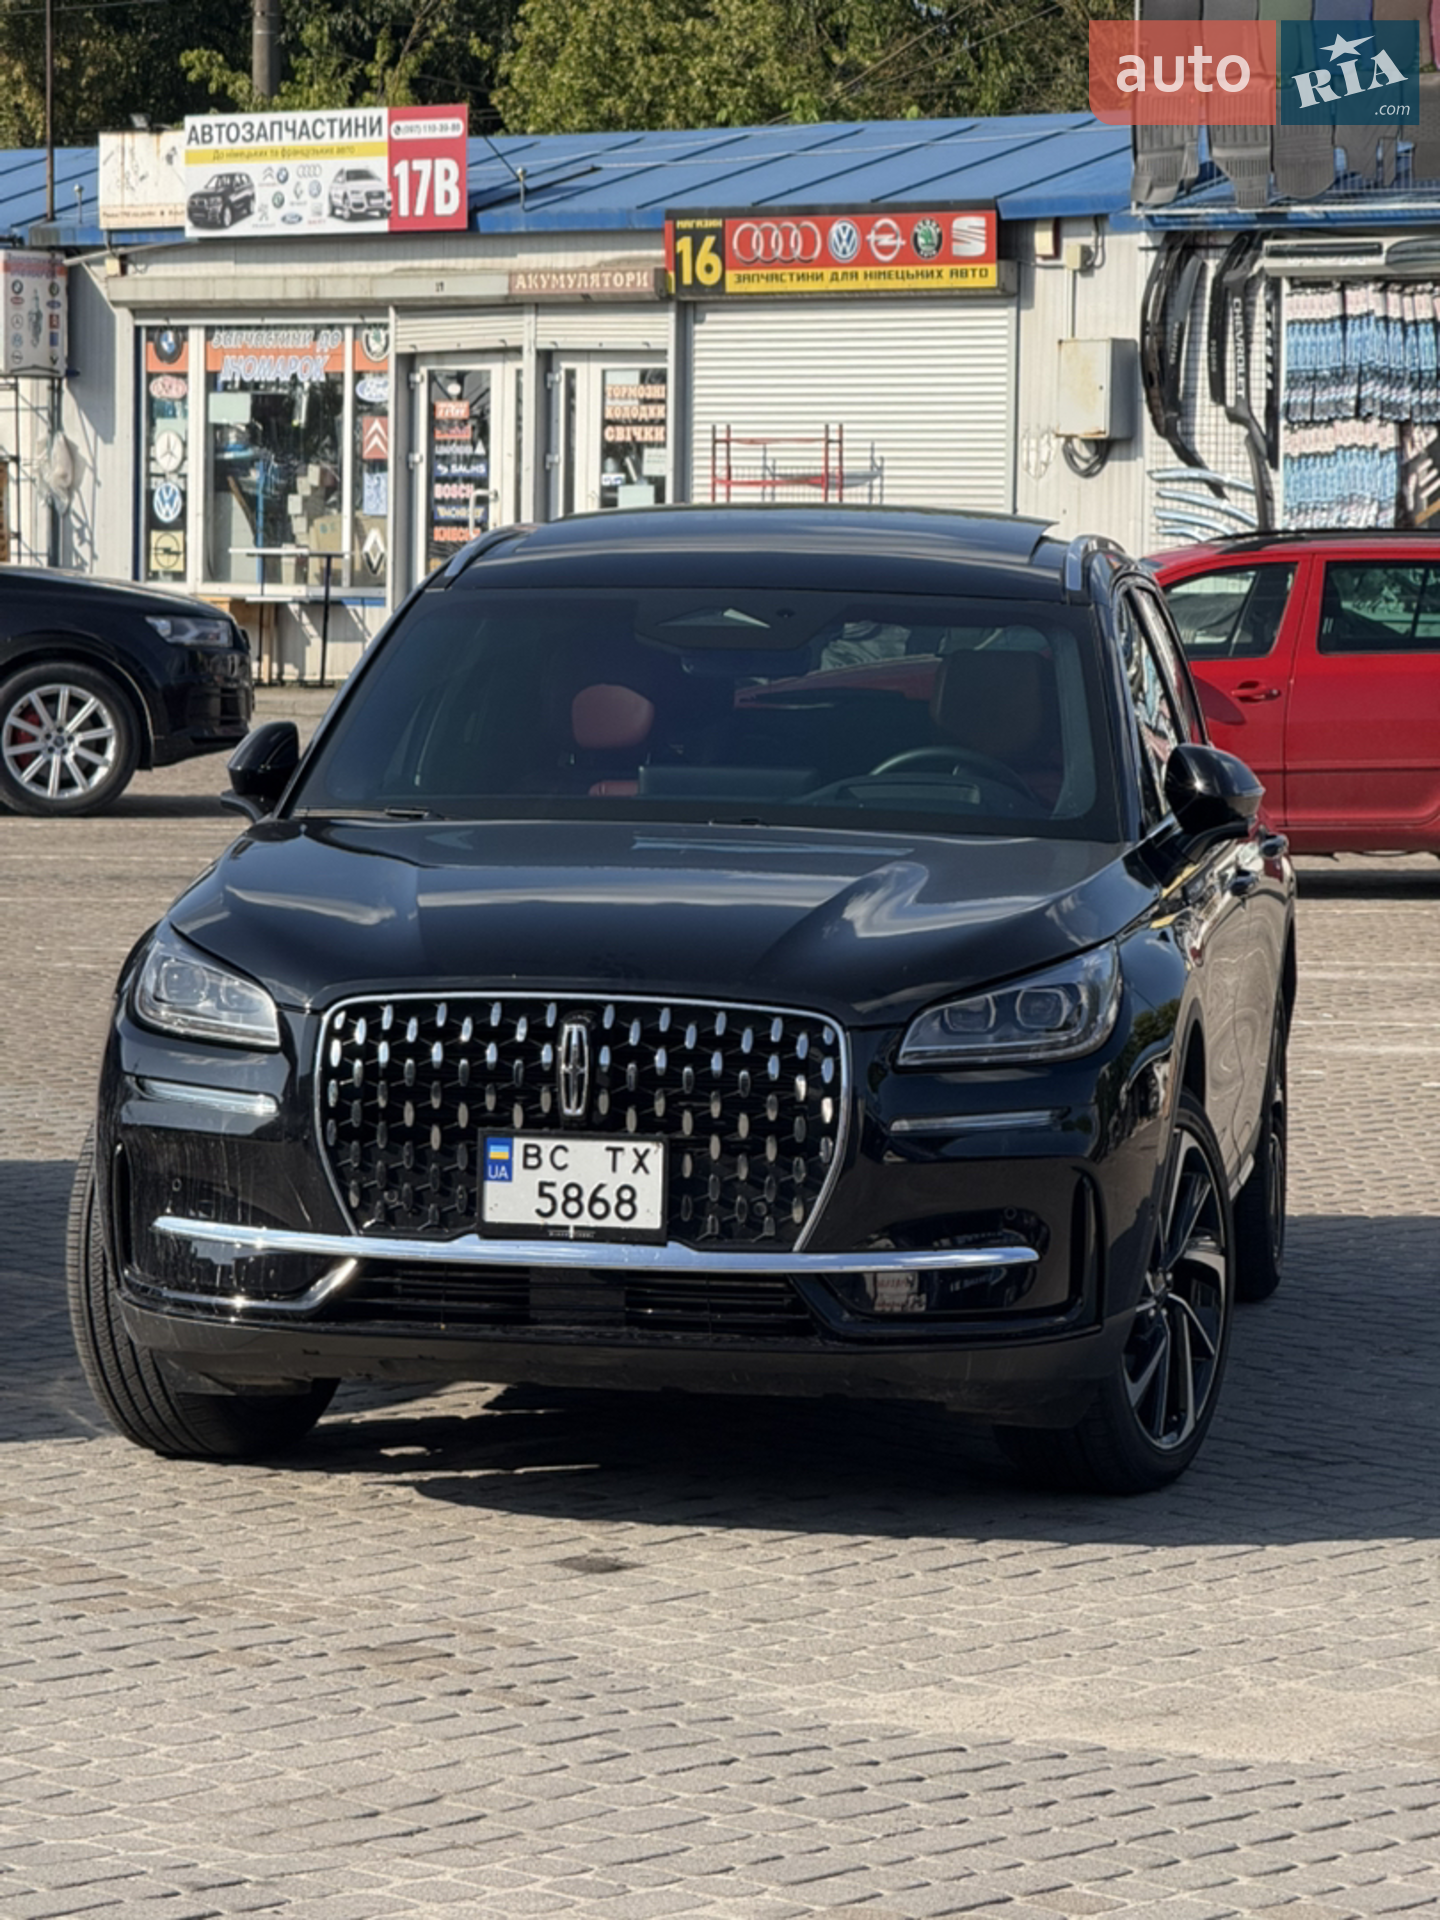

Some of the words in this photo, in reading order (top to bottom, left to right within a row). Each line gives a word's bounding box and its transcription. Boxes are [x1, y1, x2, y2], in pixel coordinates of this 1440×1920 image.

[187, 116, 382, 145] АВТОЗАПЧАСТИНИ
[676, 235, 722, 286] 16
[515, 271, 649, 289] АКУМУЛЯТОРИ
[734, 271, 824, 284] ЗАПЧАСТИНИ
[829, 270, 859, 282] ДЛЯ
[949, 267, 989, 279] АВТО
[1232, 297, 1246, 399] CHEVROLET
[604, 405, 666, 421] КОЛОДКИ
[604, 426, 665, 442] СВІЧКИ
[434, 484, 474, 499] BOSCH
[522, 1143, 569, 1171] BC
[605, 1146, 650, 1174] TX
[488, 1165, 509, 1179] UA
[534, 1181, 638, 1221] 5868
